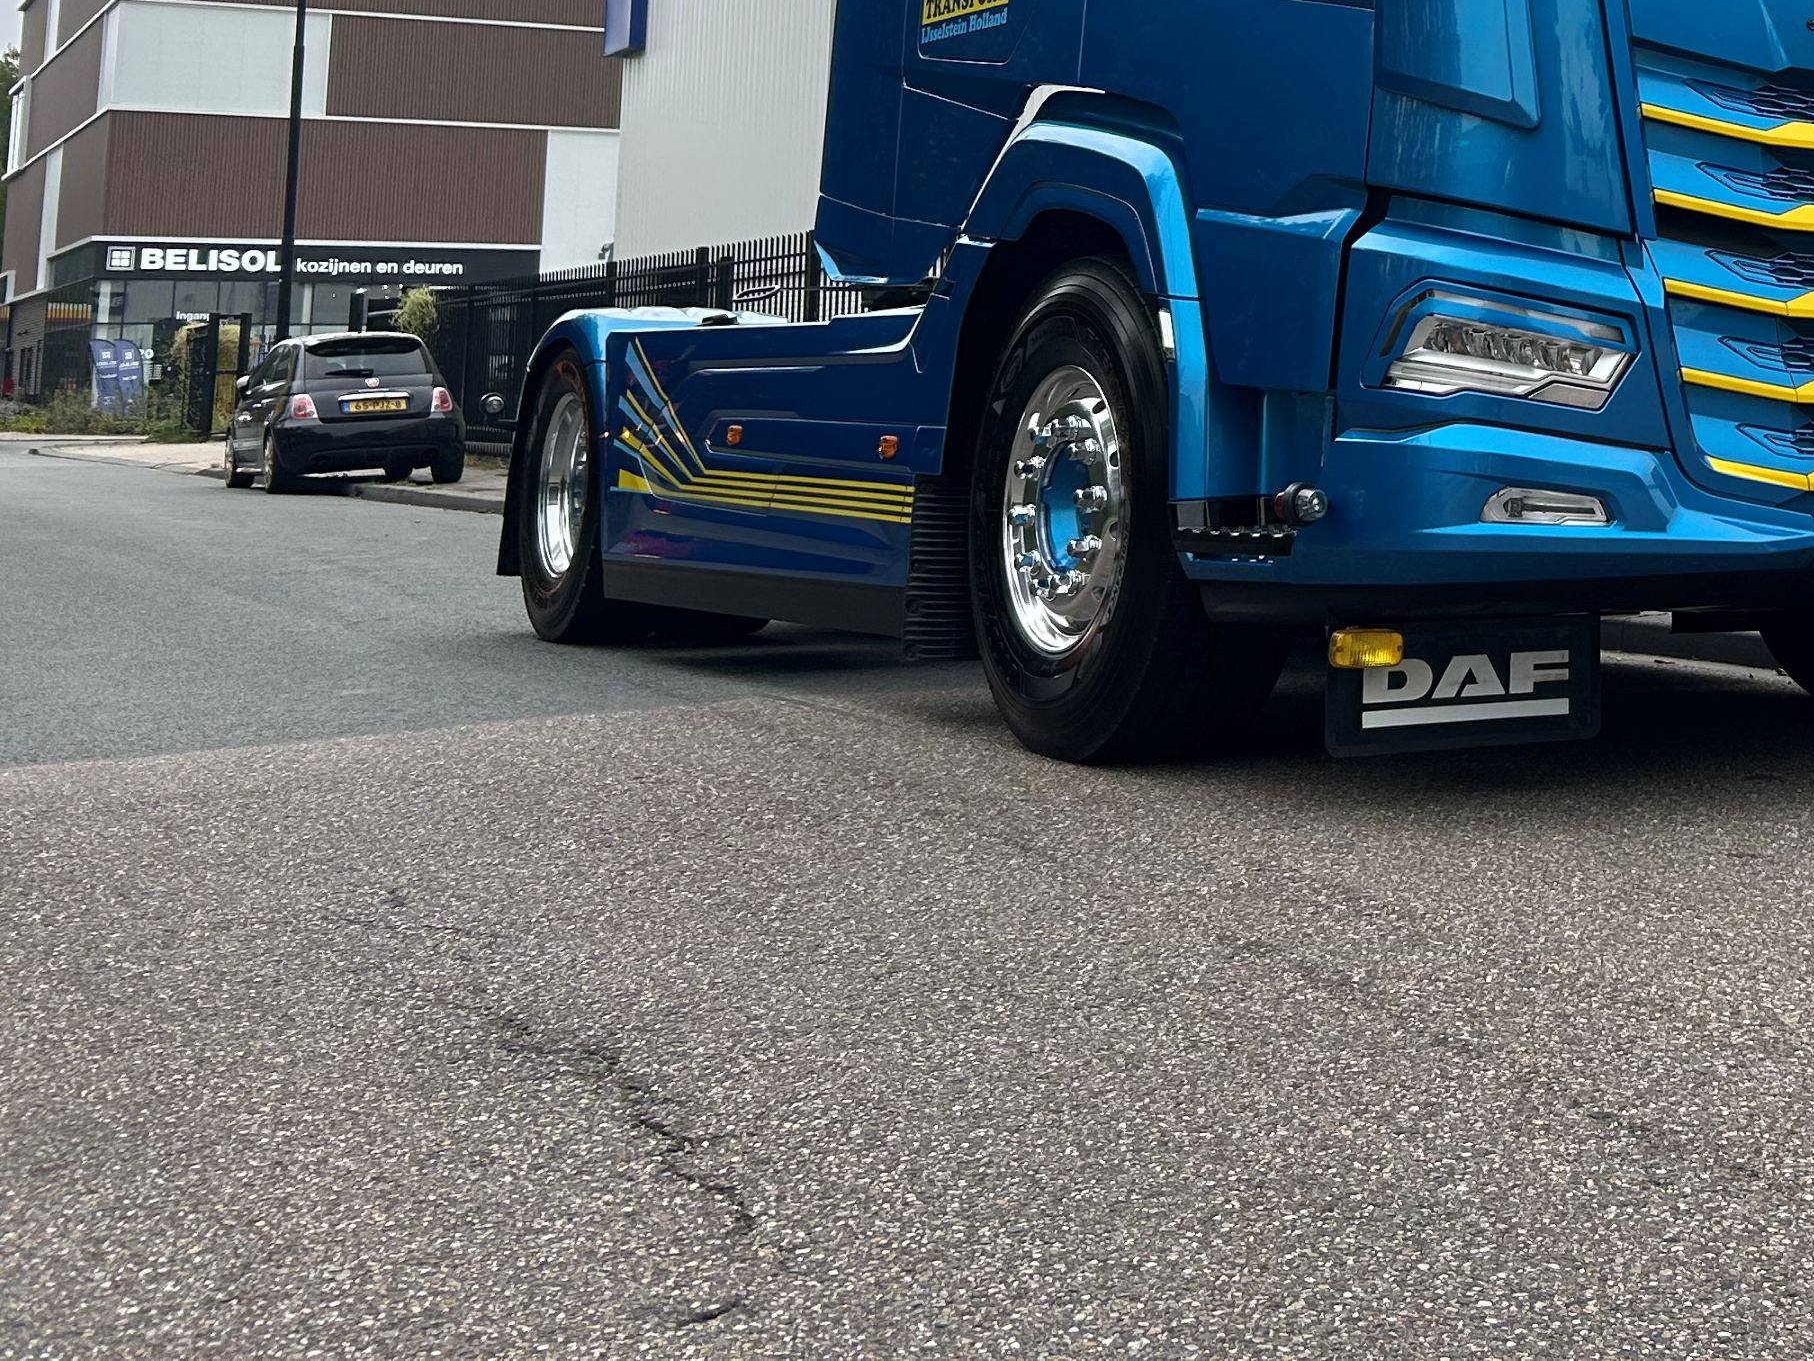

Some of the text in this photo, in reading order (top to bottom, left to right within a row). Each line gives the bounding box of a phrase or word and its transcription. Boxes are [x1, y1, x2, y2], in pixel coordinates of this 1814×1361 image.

[968, 7, 1008, 33] Holland
[140, 247, 464, 277] BELISOL kozijnen en deuren
[1362, 649, 1570, 704] DAF
